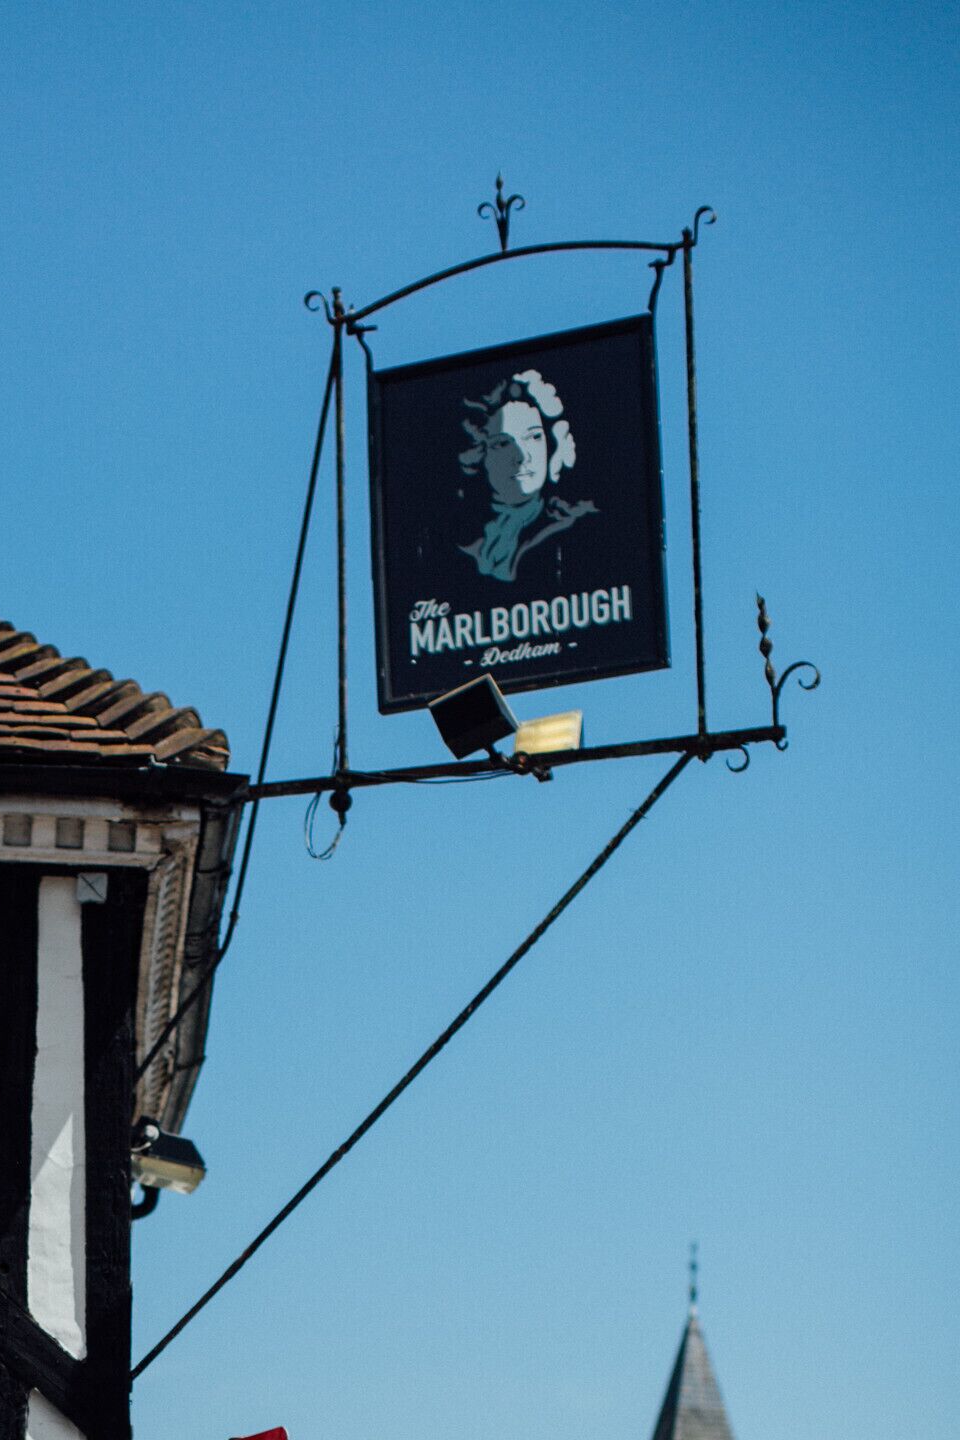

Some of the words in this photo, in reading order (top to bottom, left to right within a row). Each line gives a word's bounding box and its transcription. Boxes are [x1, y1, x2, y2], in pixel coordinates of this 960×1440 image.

[409, 599, 451, 622] The
[410, 585, 631, 656] MARLBOROUGH
[480, 642, 562, 667] Dedham
